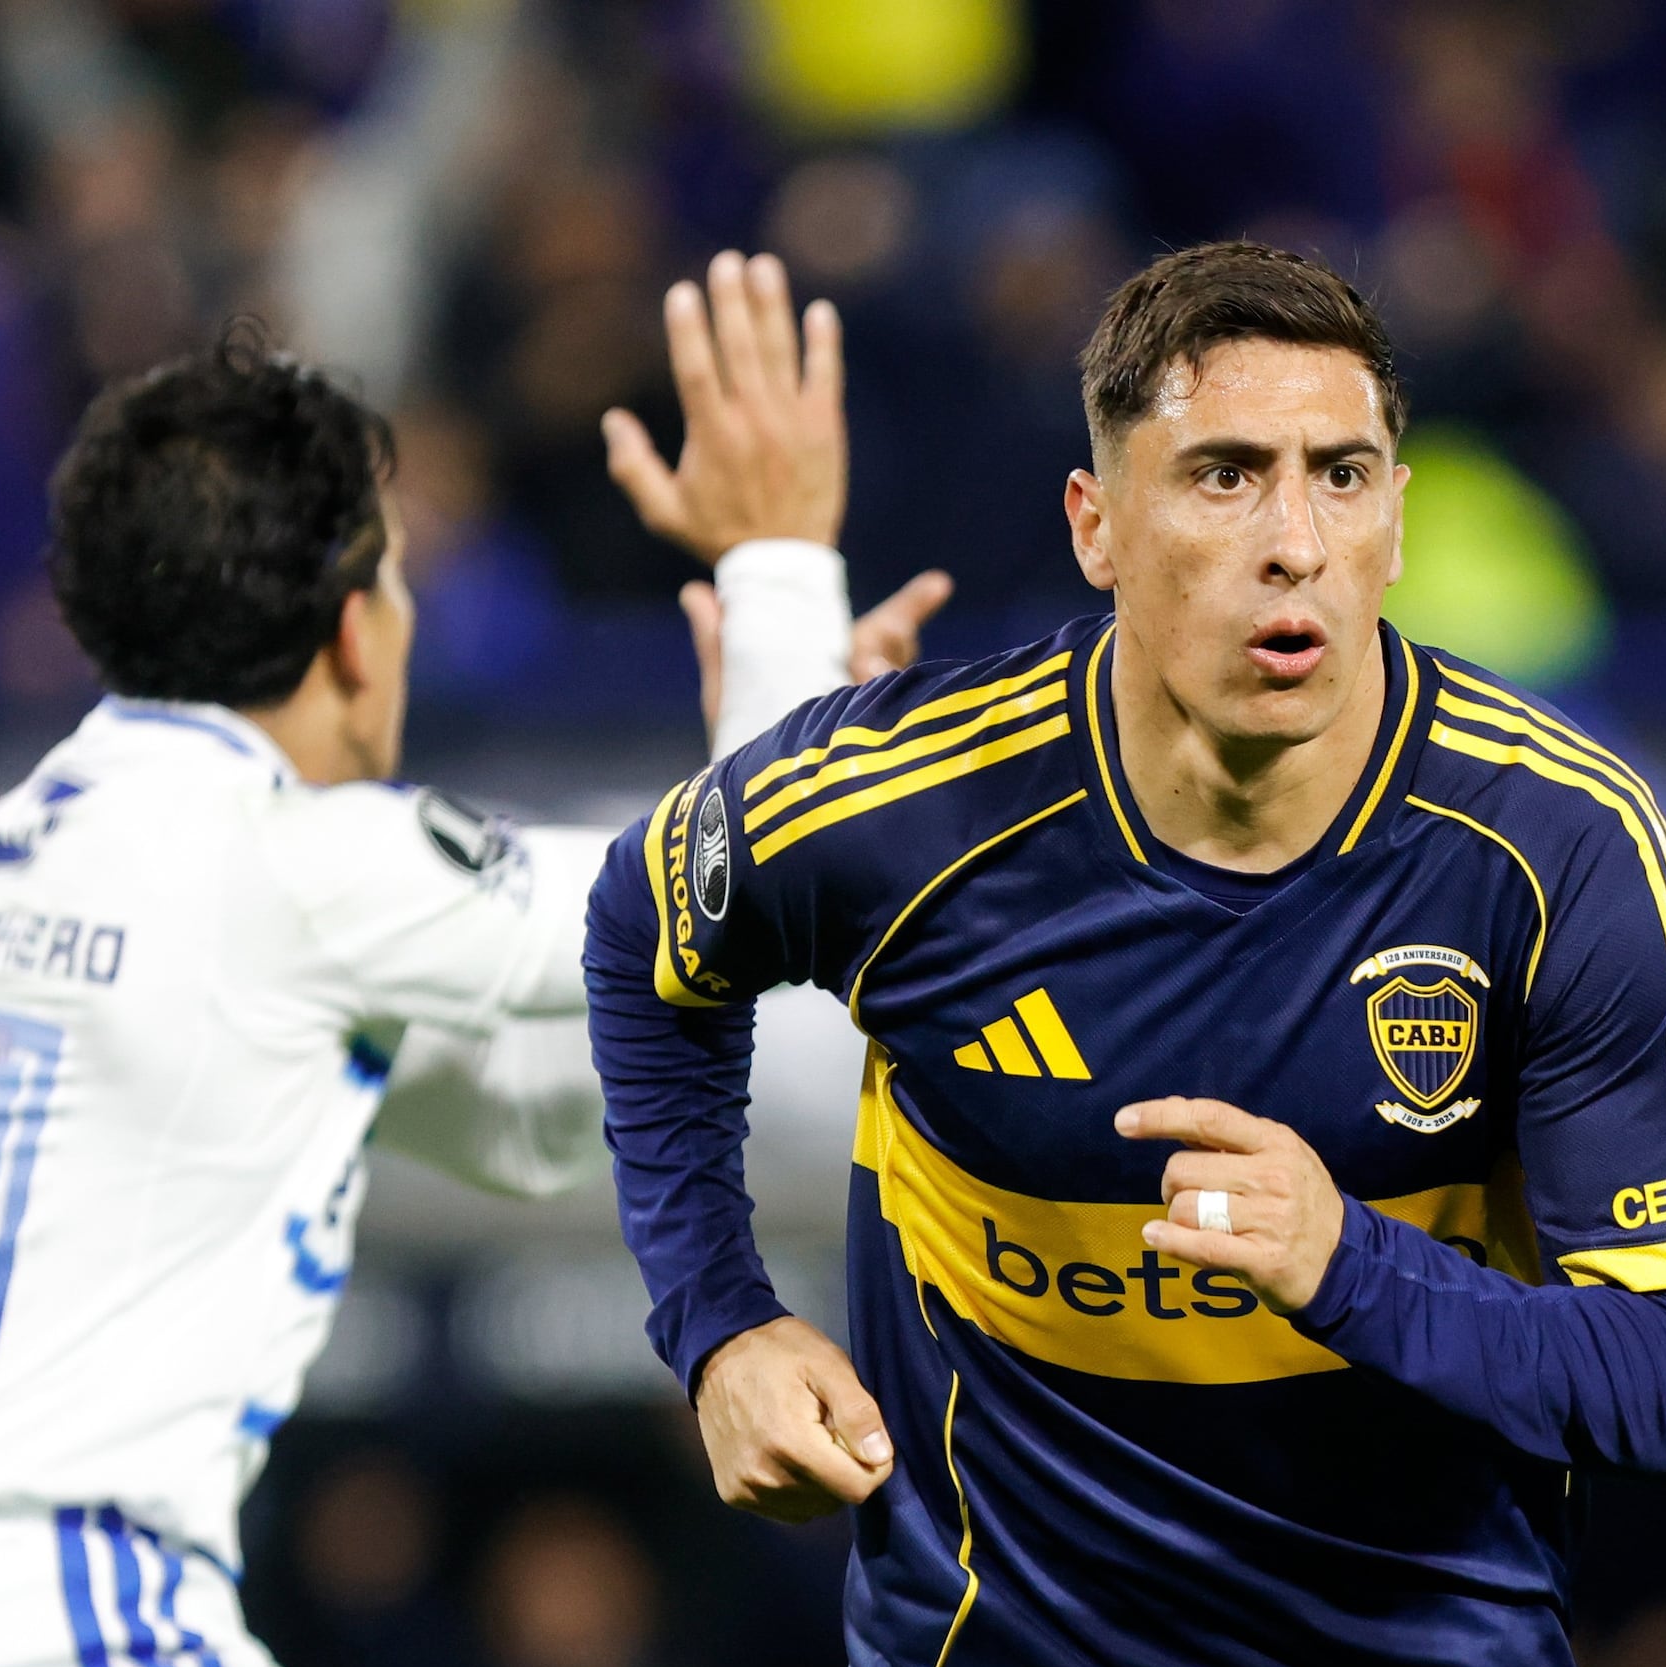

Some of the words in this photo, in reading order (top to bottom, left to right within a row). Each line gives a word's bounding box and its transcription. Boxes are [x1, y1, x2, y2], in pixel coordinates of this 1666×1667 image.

[668, 764, 731, 994] CETROGAR
[1384, 952, 1401, 964] 120
[1403, 950, 1463, 966] ANIVERSARIO
[1388, 1024, 1463, 1048] CABJ
